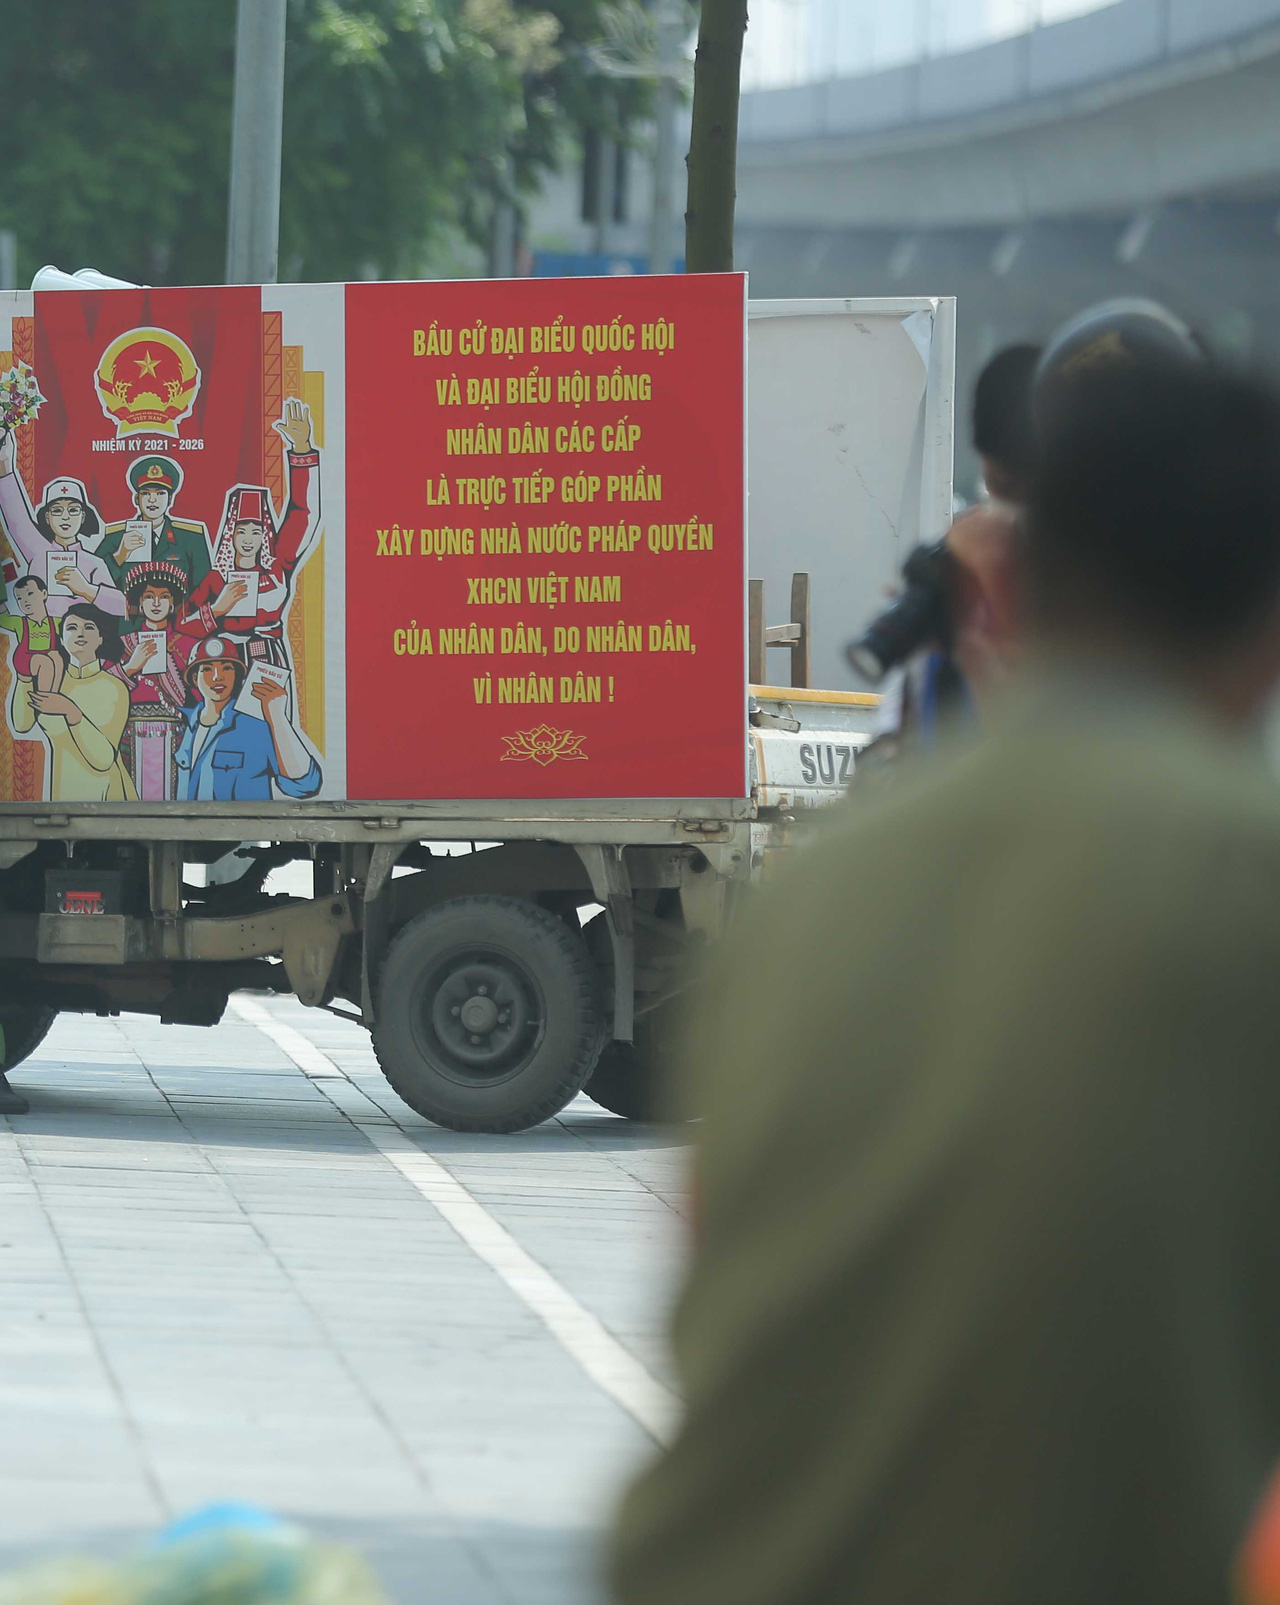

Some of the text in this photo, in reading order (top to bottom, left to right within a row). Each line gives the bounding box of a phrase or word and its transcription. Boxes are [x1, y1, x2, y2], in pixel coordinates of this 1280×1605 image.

[413, 315, 675, 360] BẦU CỬ ĐẠI BIỂU QUỐC HỘI
[436, 365, 652, 411] VÀ ĐẠI BIỂU HỘI ĐỒNG
[92, 438, 125, 453] NHIỆM
[128, 437, 142, 451] KỲ
[144, 440, 168, 451] 2021
[179, 439, 204, 451] 2026
[447, 415, 642, 455] NHÂN DÂN CÁC CẤP
[426, 465, 662, 510] LÀ TRỰC TIẾP GÓP PHẦN
[376, 515, 714, 561] XÂY DỰNG NHÀ NƯỚC PHÁP QUYỀN
[467, 571, 621, 609] XHCN VIỆT NAM
[393, 619, 697, 657] CỦA NHÂN DÂN, DO NHÂN DÂN,
[473, 670, 615, 704] VÌ NHÂN DÂN !
[800, 743, 865, 785] SUZ
